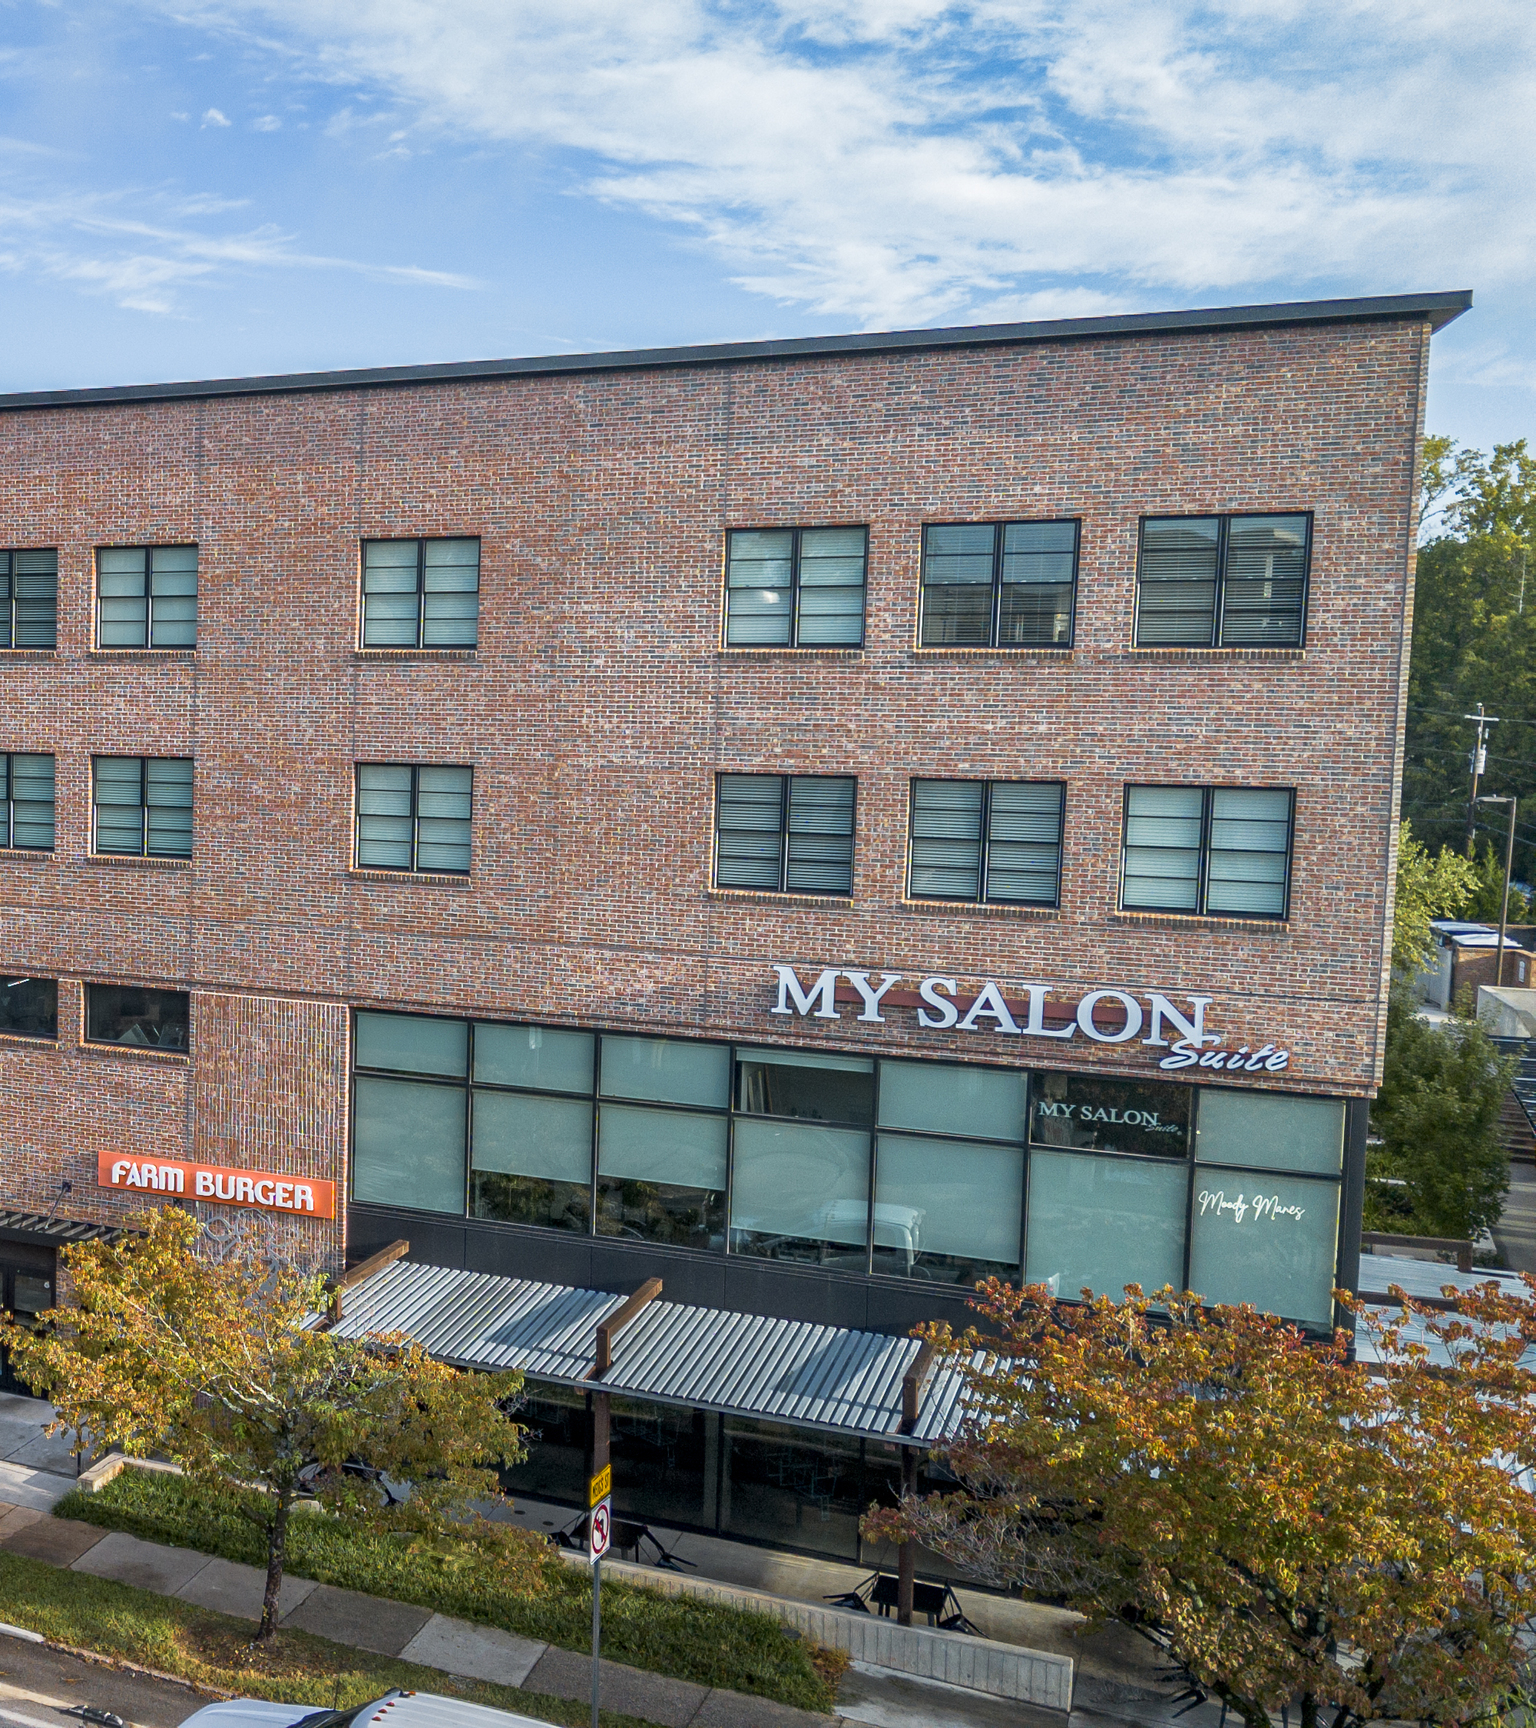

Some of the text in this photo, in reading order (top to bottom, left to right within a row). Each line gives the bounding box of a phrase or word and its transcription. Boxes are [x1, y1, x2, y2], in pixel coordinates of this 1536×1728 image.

[771, 966, 1214, 1047] MY SALON
[1159, 1034, 1289, 1072] Suite
[1038, 1101, 1161, 1126] MY SALON
[111, 1160, 314, 1211] FARM BURGER
[1198, 1190, 1306, 1223] Moody Manes
